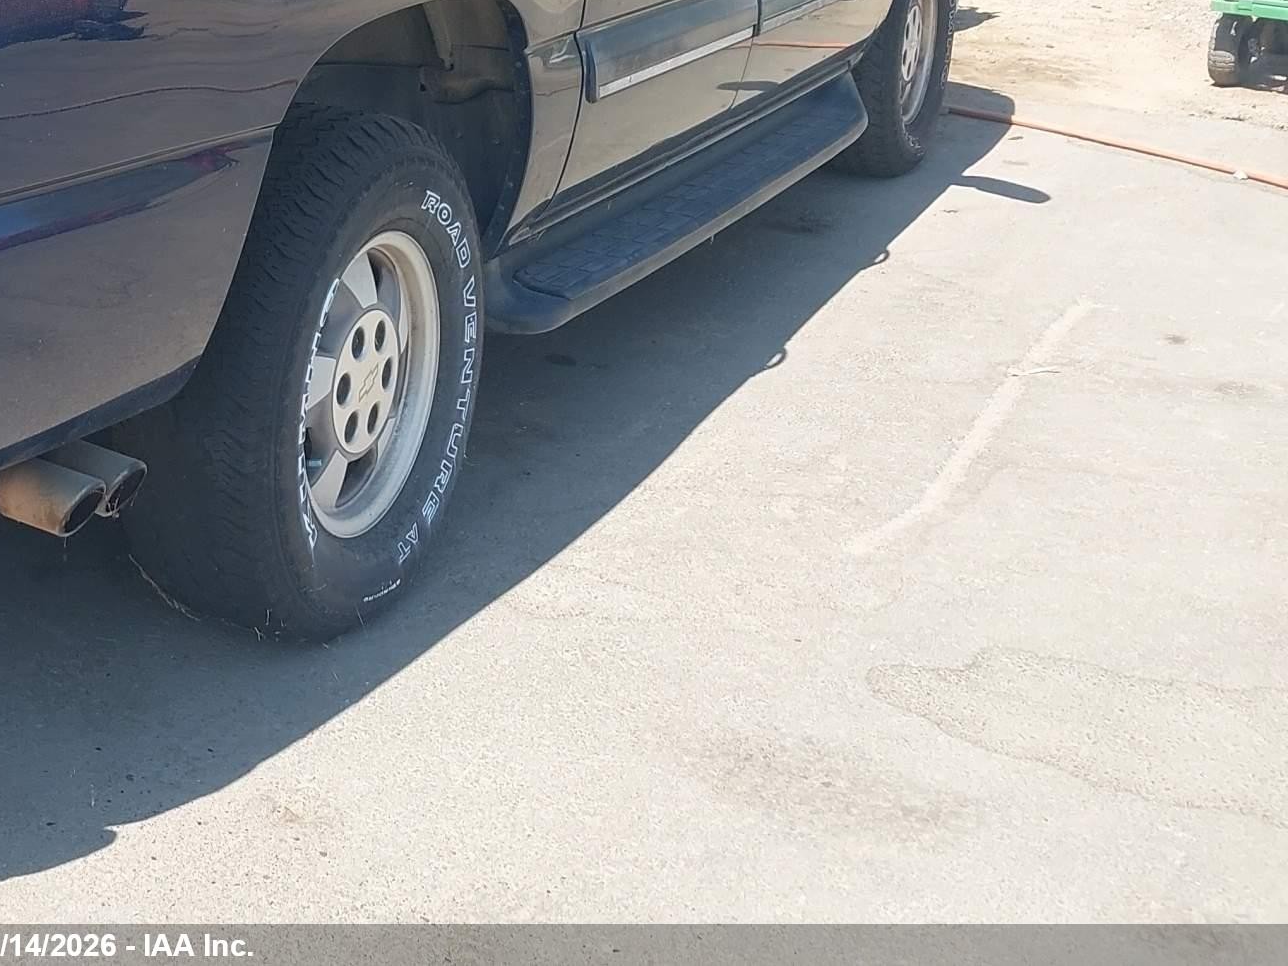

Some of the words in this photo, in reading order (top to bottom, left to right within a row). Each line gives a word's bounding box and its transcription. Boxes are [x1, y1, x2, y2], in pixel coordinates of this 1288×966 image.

[421, 190, 471, 269] ROAD
[422, 275, 478, 524] VENTURE
[397, 522, 419, 565] AT
